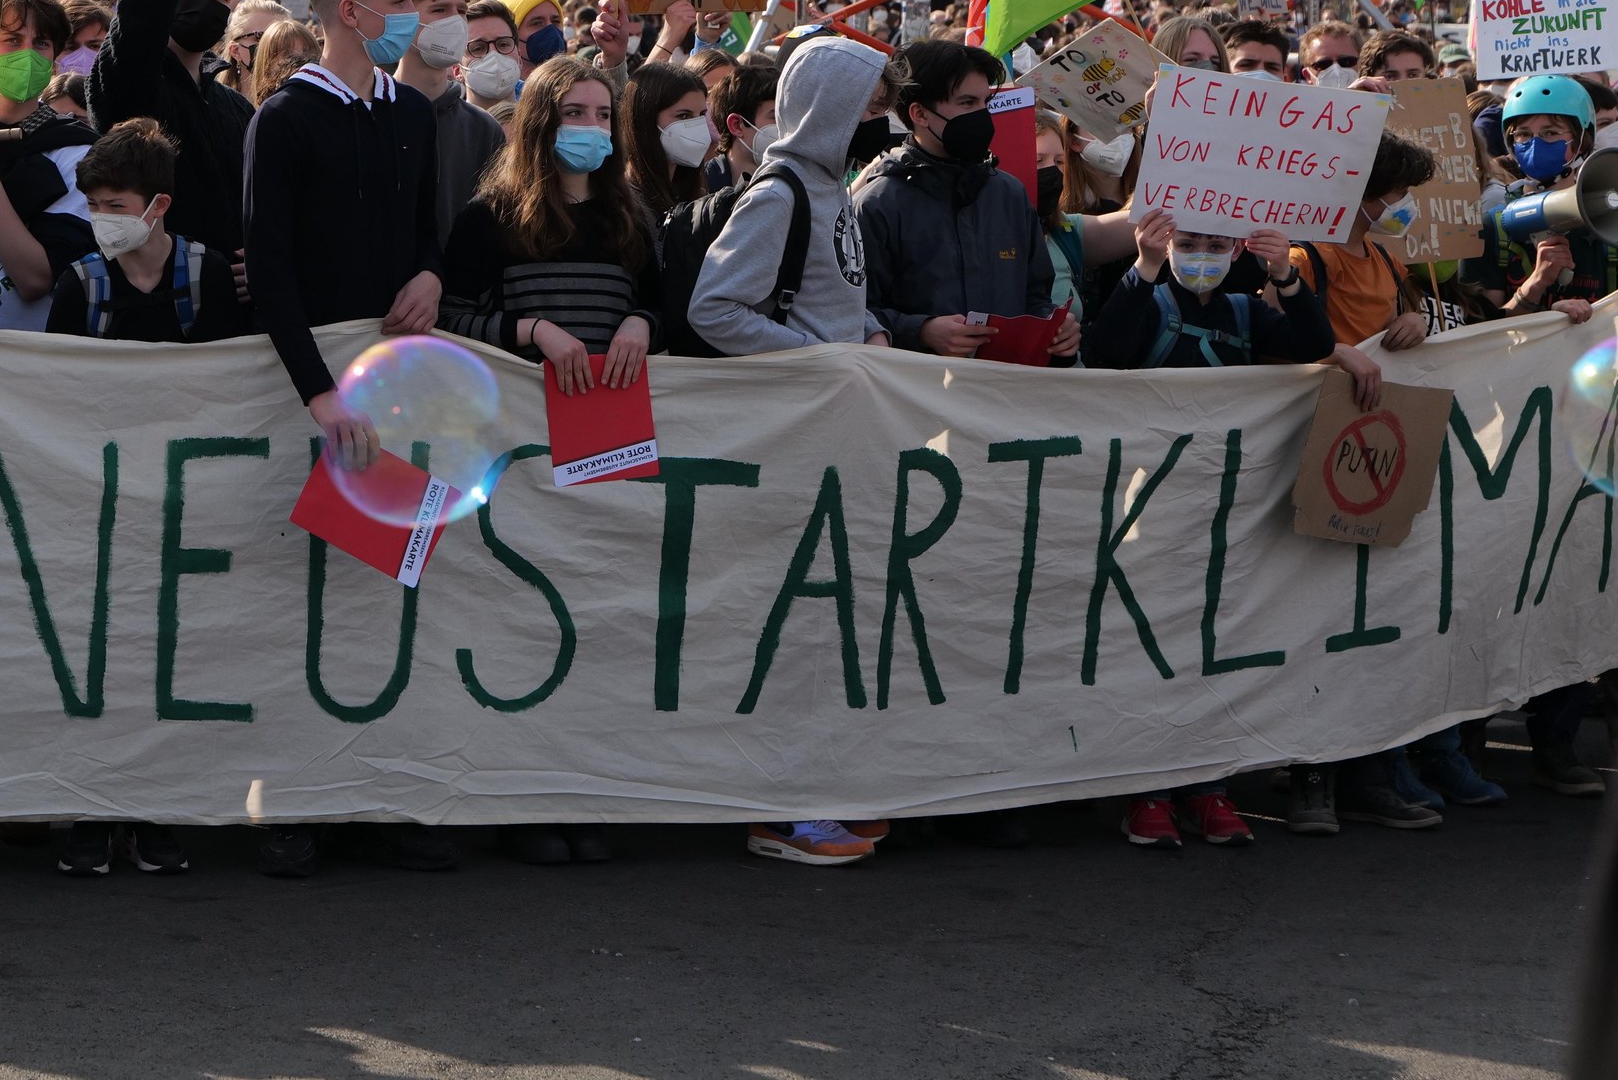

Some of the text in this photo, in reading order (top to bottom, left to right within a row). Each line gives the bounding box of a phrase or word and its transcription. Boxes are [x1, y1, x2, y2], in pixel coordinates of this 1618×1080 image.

[1512, 7, 1607, 35] ZUKUNFT
[1495, 35, 1569, 52] nicht ins
[1050, 50, 1087, 72] TO
[1501, 46, 1602, 73] KRAFTWERK
[1086, 82, 1101, 95] or
[1096, 90, 1125, 107] TO
[987, 97, 1023, 110] AKARTE
[1171, 73, 1267, 118] KEIN
[1279, 96, 1361, 134] GAS
[1157, 134, 1360, 180] VON KRIEGS-
[1145, 182, 1348, 235] VERBRECHERN!
[567, 445, 651, 475] ROTE KLIMAKARTE
[1336, 439, 1397, 479] PUTIN
[404, 484, 439, 571] ROTE KLIMAKARTE
